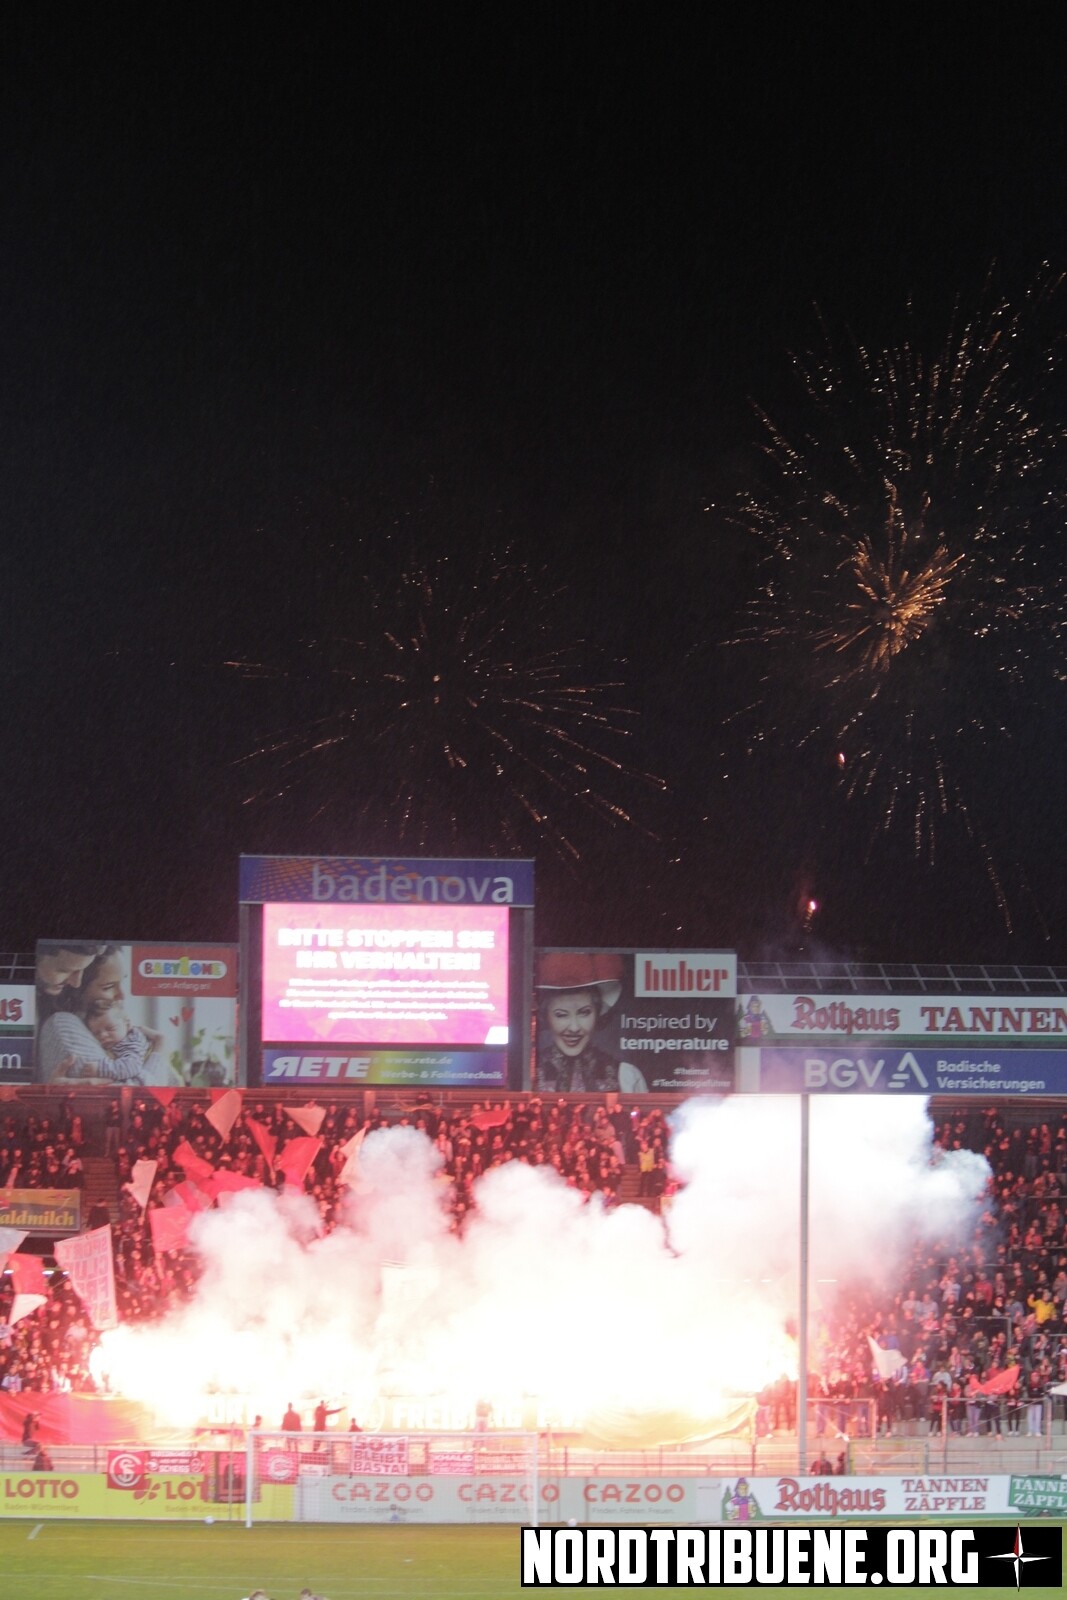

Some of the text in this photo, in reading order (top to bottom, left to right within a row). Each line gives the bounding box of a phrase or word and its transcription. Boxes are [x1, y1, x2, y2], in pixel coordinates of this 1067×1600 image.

[312, 864, 514, 903] badenova
[278, 929, 495, 948] BITTE STOPPEN SIE
[296, 951, 337, 968] IHR
[644, 960, 728, 992] huber
[620, 1014, 718, 1032] Inspired by
[790, 996, 901, 1036] Rothaus
[620, 1037, 729, 1053] temperature
[803, 1058, 885, 1088] BGV
[936, 1060, 1001, 1073] Badische
[936, 1076, 1046, 1092] Versicherungen
[5, 1478, 79, 1499] LOTTO
[331, 1482, 434, 1502] CAZOO
[582, 1483, 685, 1503] CAZOO
[902, 1478, 989, 1493] TANNEN
[774, 1477, 887, 1516] Rothaus
[905, 1494, 986, 1511] ZÄPFLE
